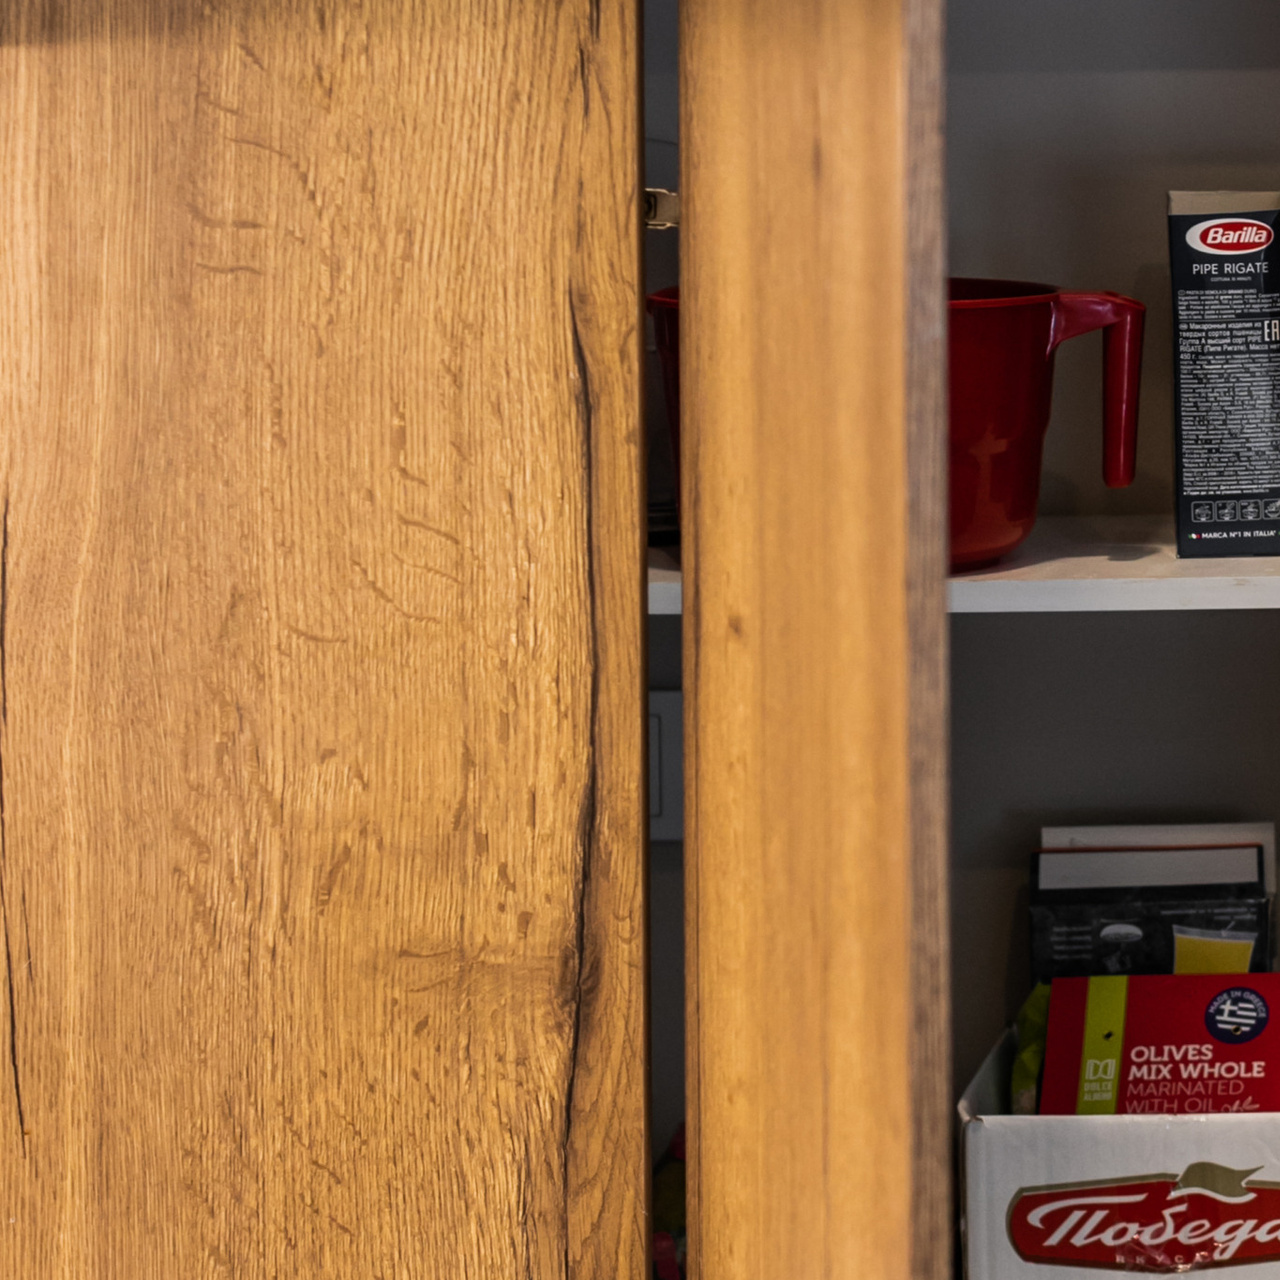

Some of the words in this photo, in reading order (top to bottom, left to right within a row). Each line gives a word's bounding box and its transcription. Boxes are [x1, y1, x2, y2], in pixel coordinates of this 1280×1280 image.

[1206, 226, 1267, 244] Barilla
[1192, 263, 1218, 275] PIPE
[1224, 262, 1269, 274] RIGATE
[1208, 992, 1230, 1014] MADE
[1230, 990, 1242, 998] IN
[1243, 990, 1267, 1018] GREECE
[1130, 1043, 1214, 1063] OLIVES
[1127, 1063, 1174, 1081] MIX
[1179, 1061, 1266, 1079] WHOLE
[1126, 1080, 1245, 1098] MARINATED
[1125, 1098, 1178, 1114] WITH
[1184, 1097, 1219, 1113] OIL
